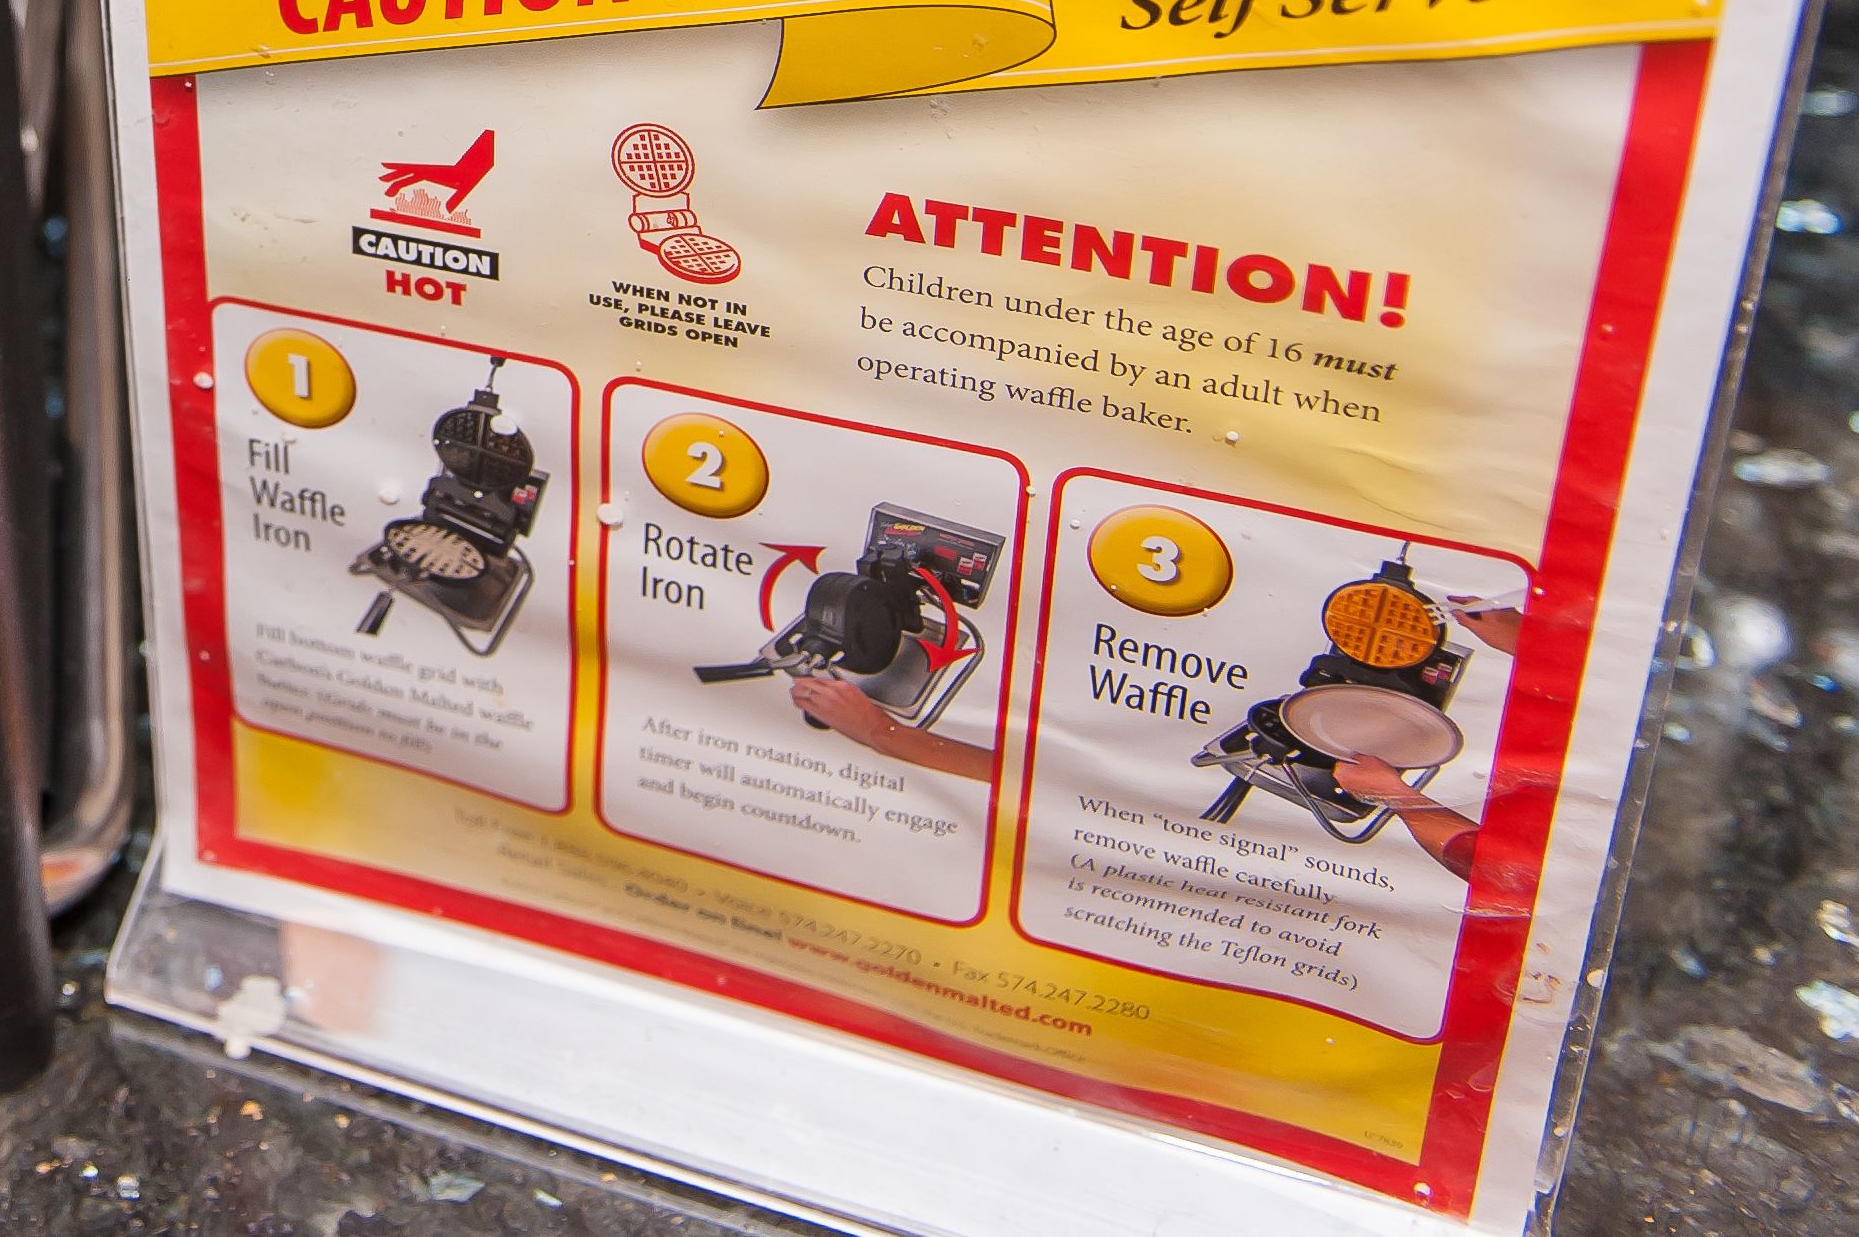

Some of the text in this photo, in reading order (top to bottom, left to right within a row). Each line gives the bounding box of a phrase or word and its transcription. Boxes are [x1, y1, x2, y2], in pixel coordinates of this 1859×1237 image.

[359, 233, 491, 275] CAUTION
[864, 192, 1411, 329] ATTENTION!
[385, 270, 467, 306] HOT
[589, 293, 771, 338] USE, PLEASE LEAVE
[612, 282, 748, 317] WHEN NOT IN
[619, 315, 739, 348] GRIDS OPEN
[863, 264, 1399, 382] Children under the age of 16 must
[287, 354, 310, 398] 1
[857, 353, 1193, 434] operating waffle baker.
[860, 306, 1381, 424] be accompanied by an adult when
[248, 438, 290, 475] Fill
[686, 442, 723, 488] 2
[249, 476, 346, 526] Waffle
[252, 515, 311, 552] Iron
[643, 522, 754, 575] Rotate
[1136, 536, 1182, 582] 3
[641, 566, 705, 610] Iron
[360, 649, 414, 672] waffle
[418, 664, 456, 683] grid
[461, 674, 504, 695] with
[1093, 624, 1250, 691] Remove
[409, 687, 474, 716] Malted
[1089, 664, 1212, 724] Waffle
[642, 715, 906, 793] After iron rotation, digital
[638, 775, 862, 843] and begin countdown.
[640, 746, 958, 837] timer will automatically engage
[1074, 828, 1336, 905] remove waffle carefully
[1076, 794, 1145, 827] When
[1304, 853, 1396, 892] sounds,
[1068, 877, 1342, 957] is recommended to avoid
[1069, 853, 1383, 940] (A plastic heat resistant fork
[1064, 907, 1358, 991] scratching the Teflon grids)
[788, 936, 1092, 1037] www.goldenmalted.com
[953, 960, 989, 982] Fax
[997, 972, 1150, 1020] 574.247.2280
